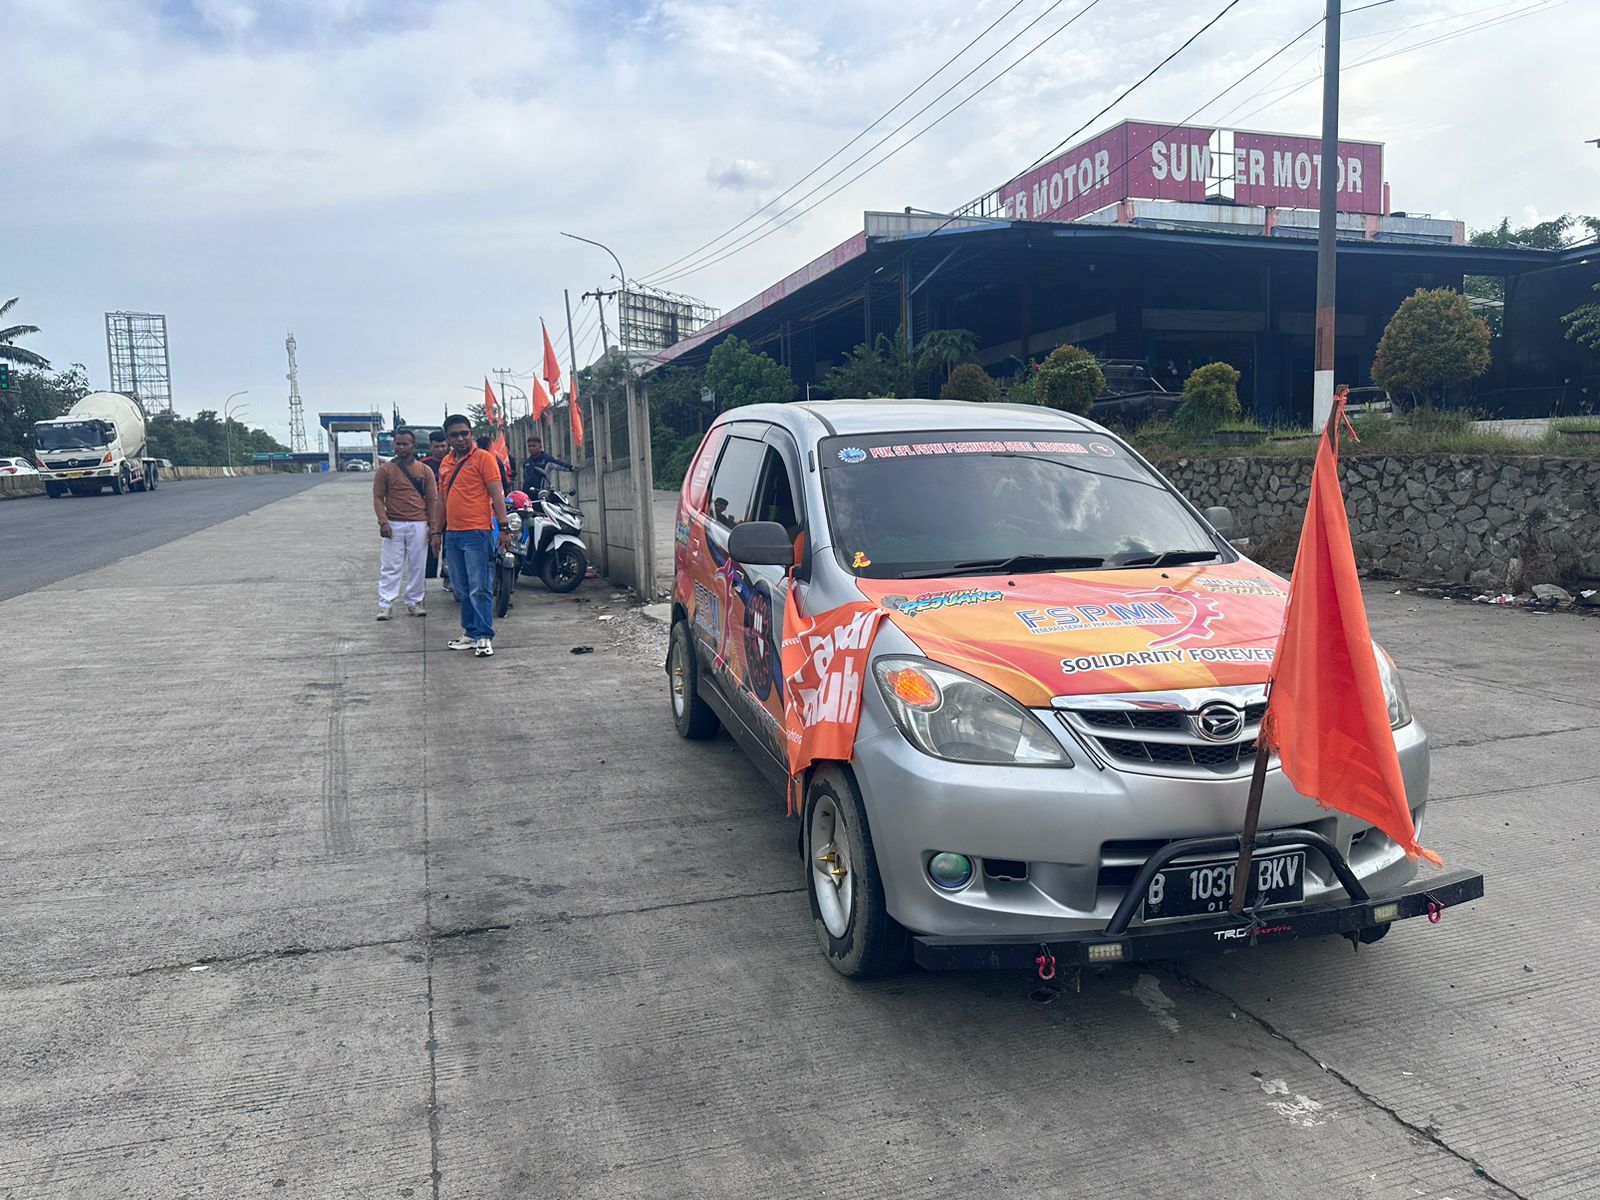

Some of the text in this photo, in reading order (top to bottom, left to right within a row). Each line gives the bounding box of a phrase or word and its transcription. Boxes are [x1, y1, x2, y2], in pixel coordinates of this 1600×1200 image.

[1151, 140, 1266, 186] SUMER
[1033, 149, 1111, 217] MOTOR
[869, 446, 896, 458] PUK
[899, 591, 1004, 615] PEJUANG
[1015, 602, 1176, 629] FSPMI
[1062, 648, 1275, 674] SOLIDARITY FOREVER
[1148, 855, 1299, 905] B 1031 BKV
[1213, 929, 1247, 940] TRD
